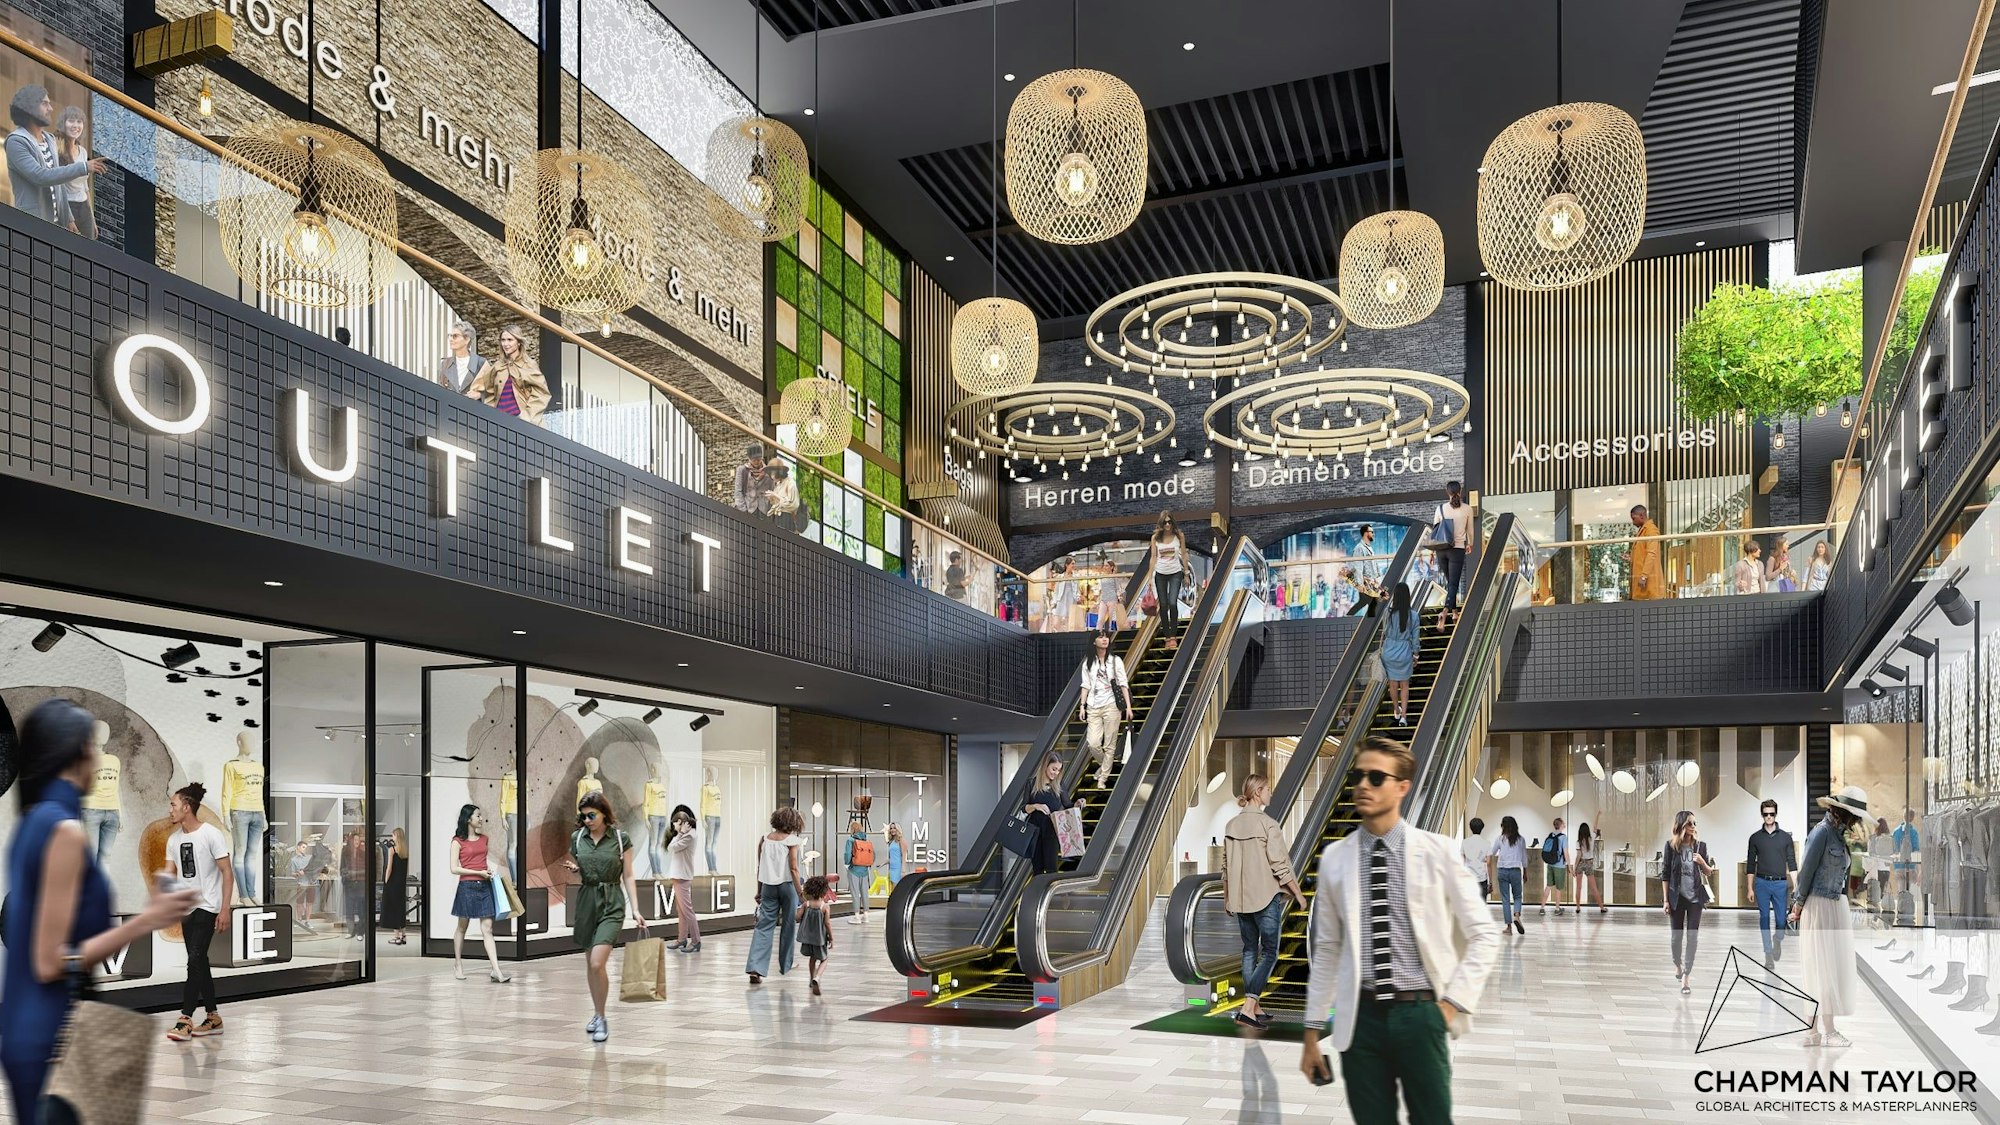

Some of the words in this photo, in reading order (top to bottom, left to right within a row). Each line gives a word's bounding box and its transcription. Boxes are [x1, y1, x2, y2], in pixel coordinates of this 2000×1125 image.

[211, 0, 343, 80] ode
[367, 64, 398, 119] &
[668, 266, 684, 304] &
[696, 290, 753, 346] mehr
[1510, 427, 1717, 464] Accessories
[1859, 272, 1976, 573] OUTLET
[112, 333, 721, 593] OUTLET
[944, 453, 973, 490] Bags
[1025, 486, 1110, 508] Herren
[1124, 474, 1196, 499] mode
[1249, 462, 1348, 488] Damen
[1364, 451, 1445, 477] mode
